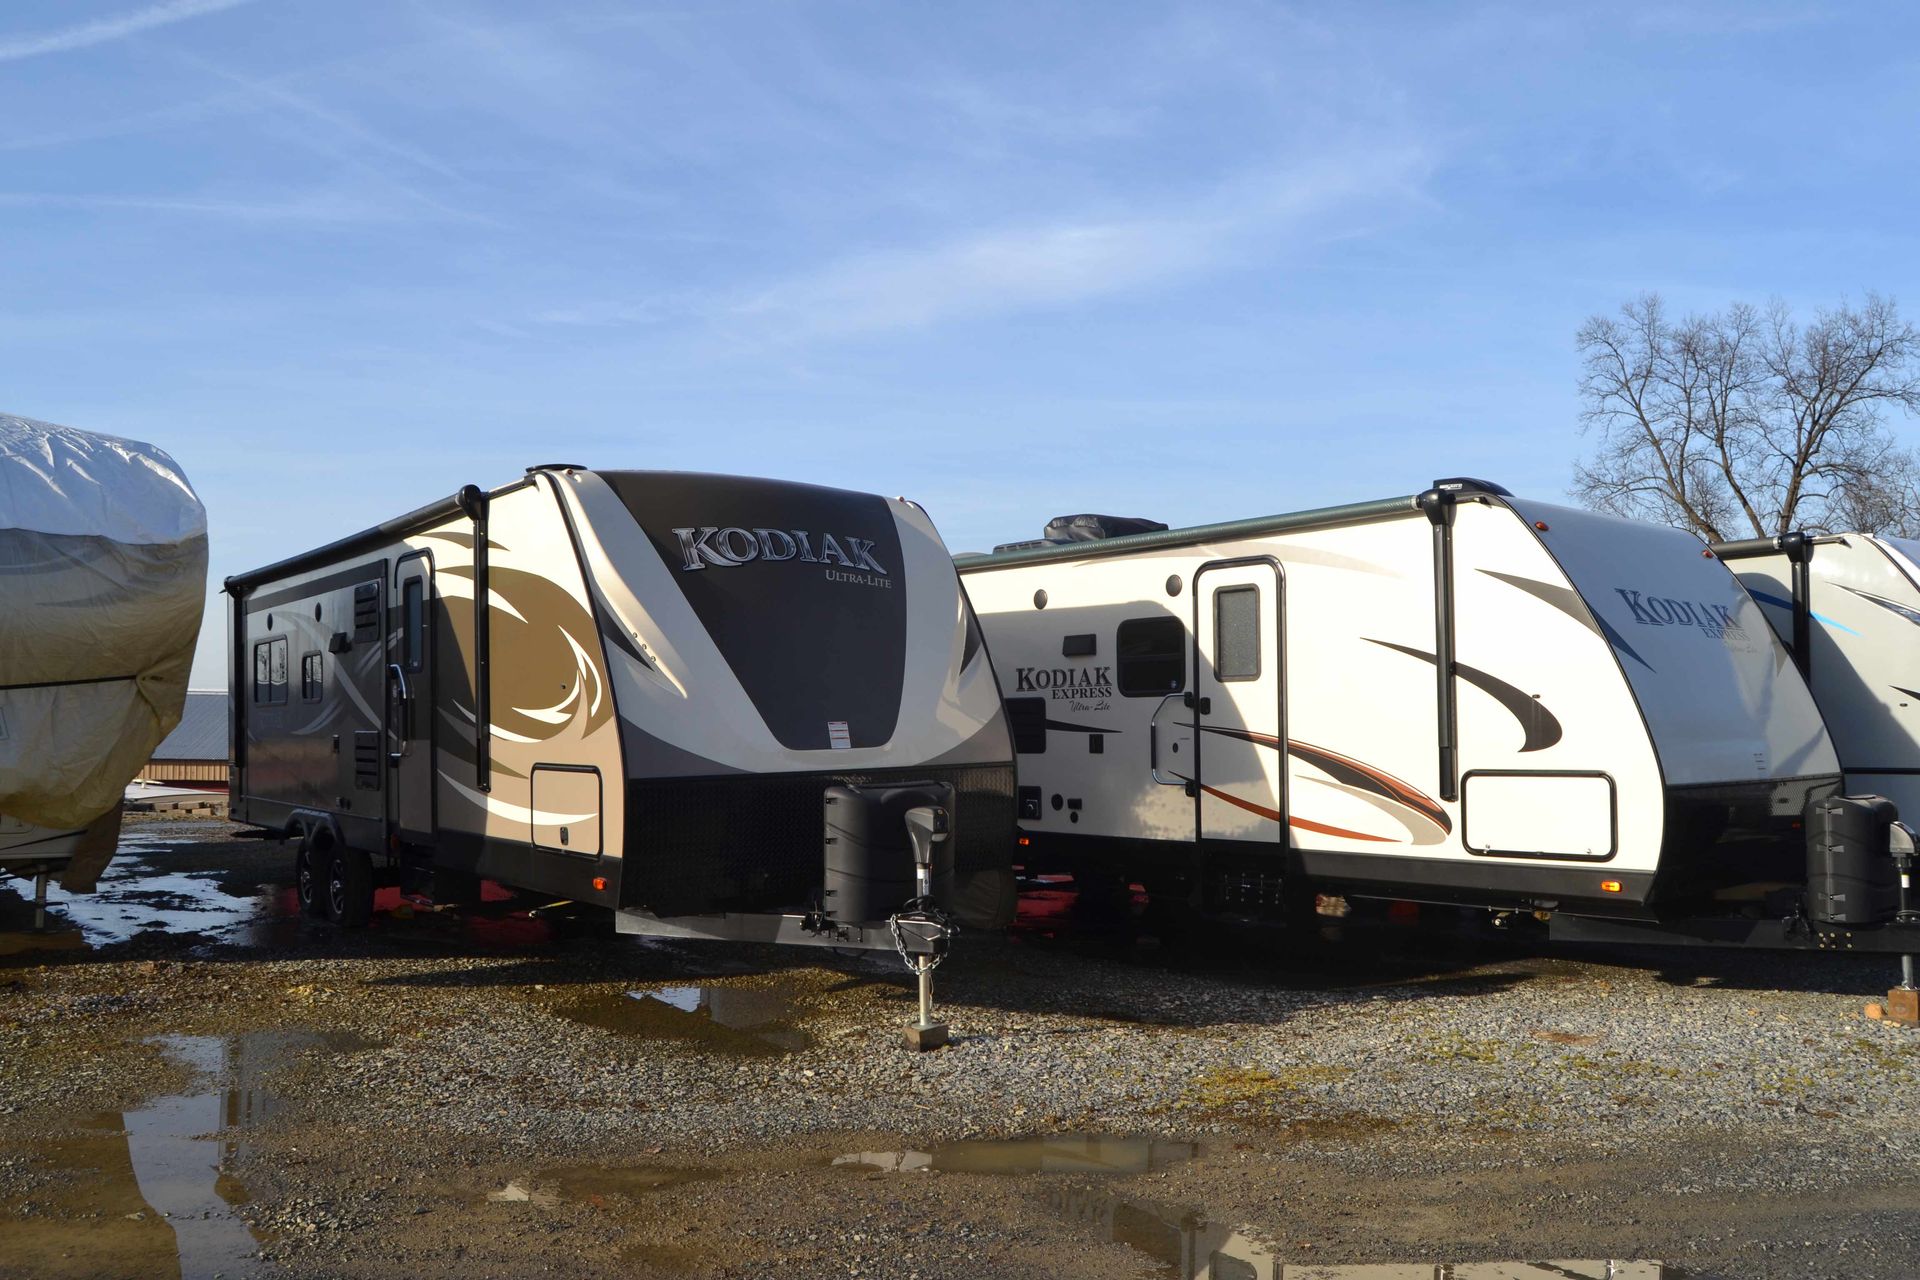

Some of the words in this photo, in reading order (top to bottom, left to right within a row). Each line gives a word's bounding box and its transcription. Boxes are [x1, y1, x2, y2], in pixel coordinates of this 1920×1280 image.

[671, 526, 888, 575] KODIAK
[1614, 588, 1744, 630] KODIAK
[1015, 666, 1113, 692] KODIAK
[1052, 687, 1112, 700] EXPRESS
[1069, 700, 1112, 712] Ultra-Lite
